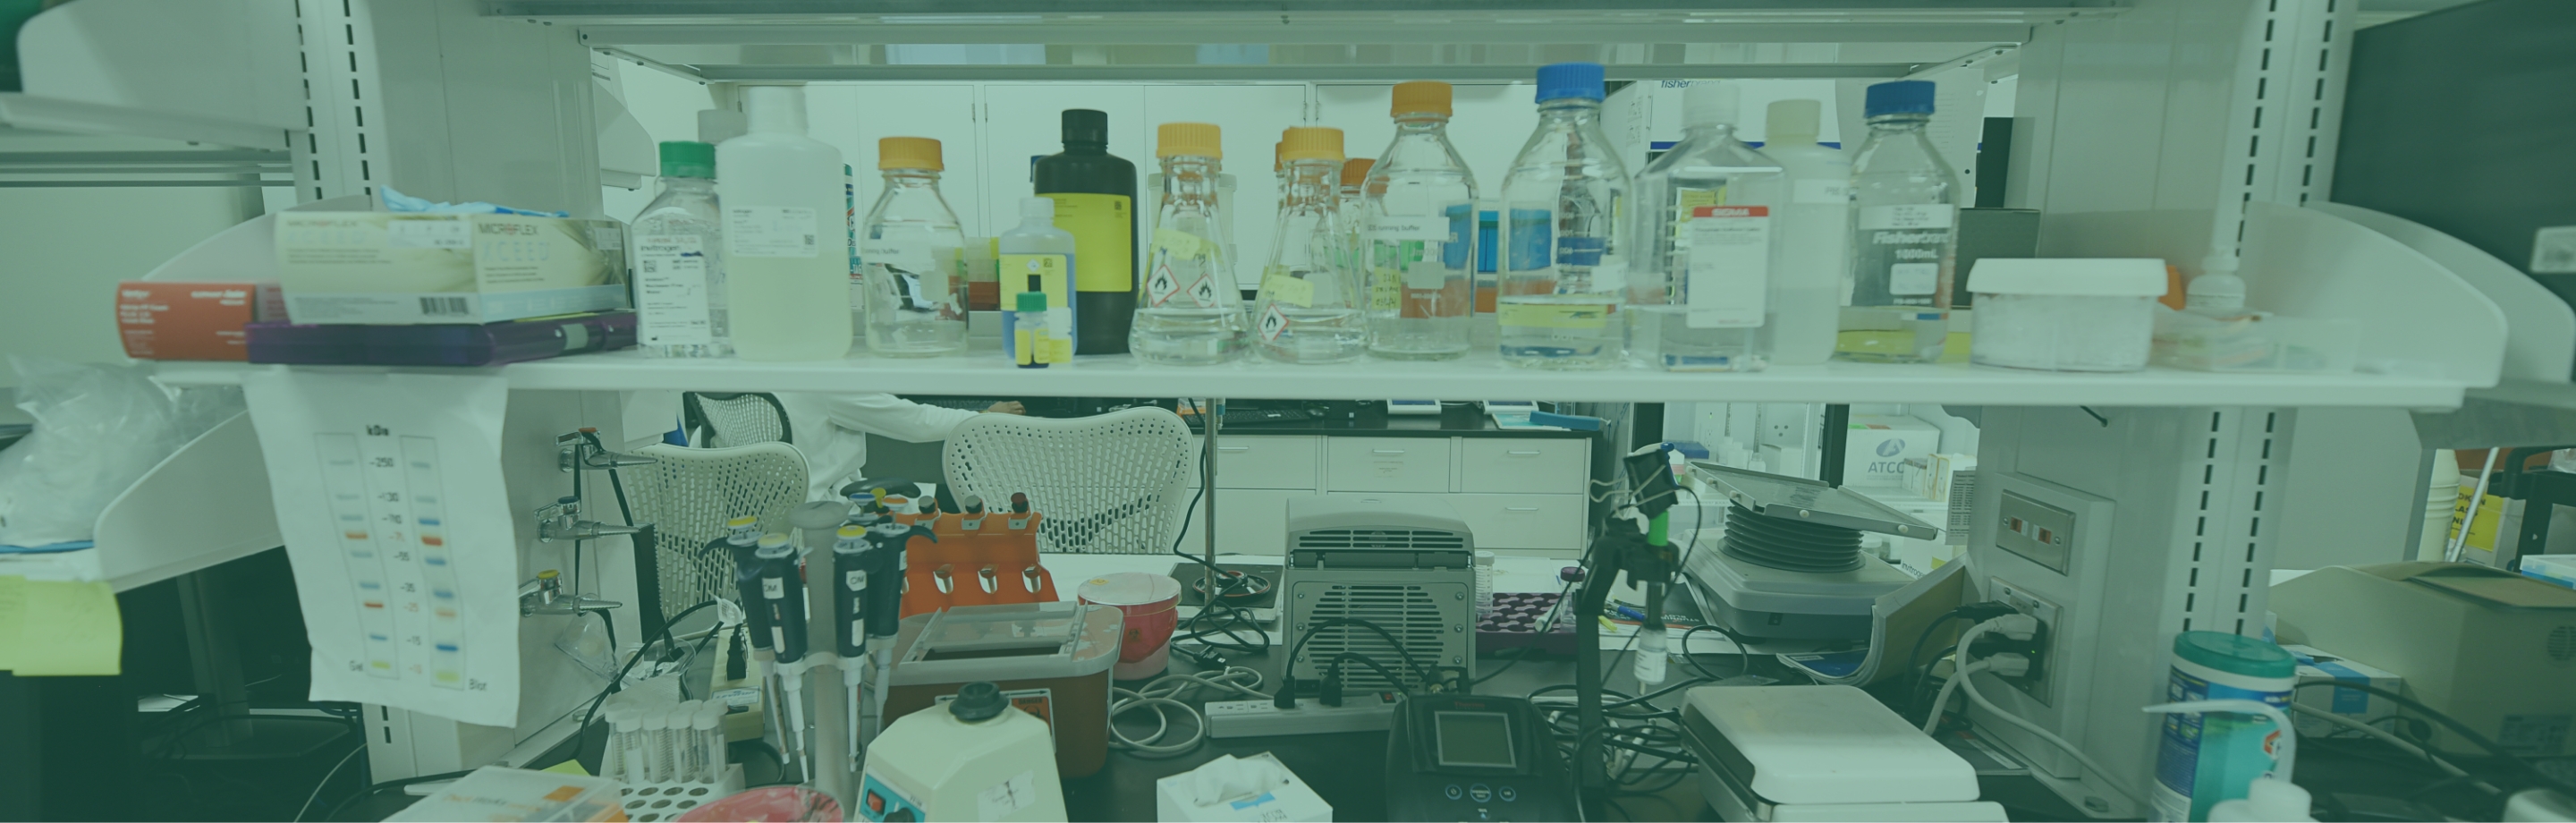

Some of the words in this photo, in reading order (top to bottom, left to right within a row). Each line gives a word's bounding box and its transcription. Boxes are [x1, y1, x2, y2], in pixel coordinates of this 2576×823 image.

[479, 223, 538, 235] MICROFLEX
[1378, 225, 1400, 233] running
[1872, 231, 1950, 244] Fisherbrand
[481, 242, 549, 261] XCEED
[1894, 249, 1938, 259] 1000mL
[366, 425, 390, 437] kDa
[1868, 462, 1905, 473] ATCC
[350, 660, 363, 671] Gel
[469, 678, 487, 691] Blot
